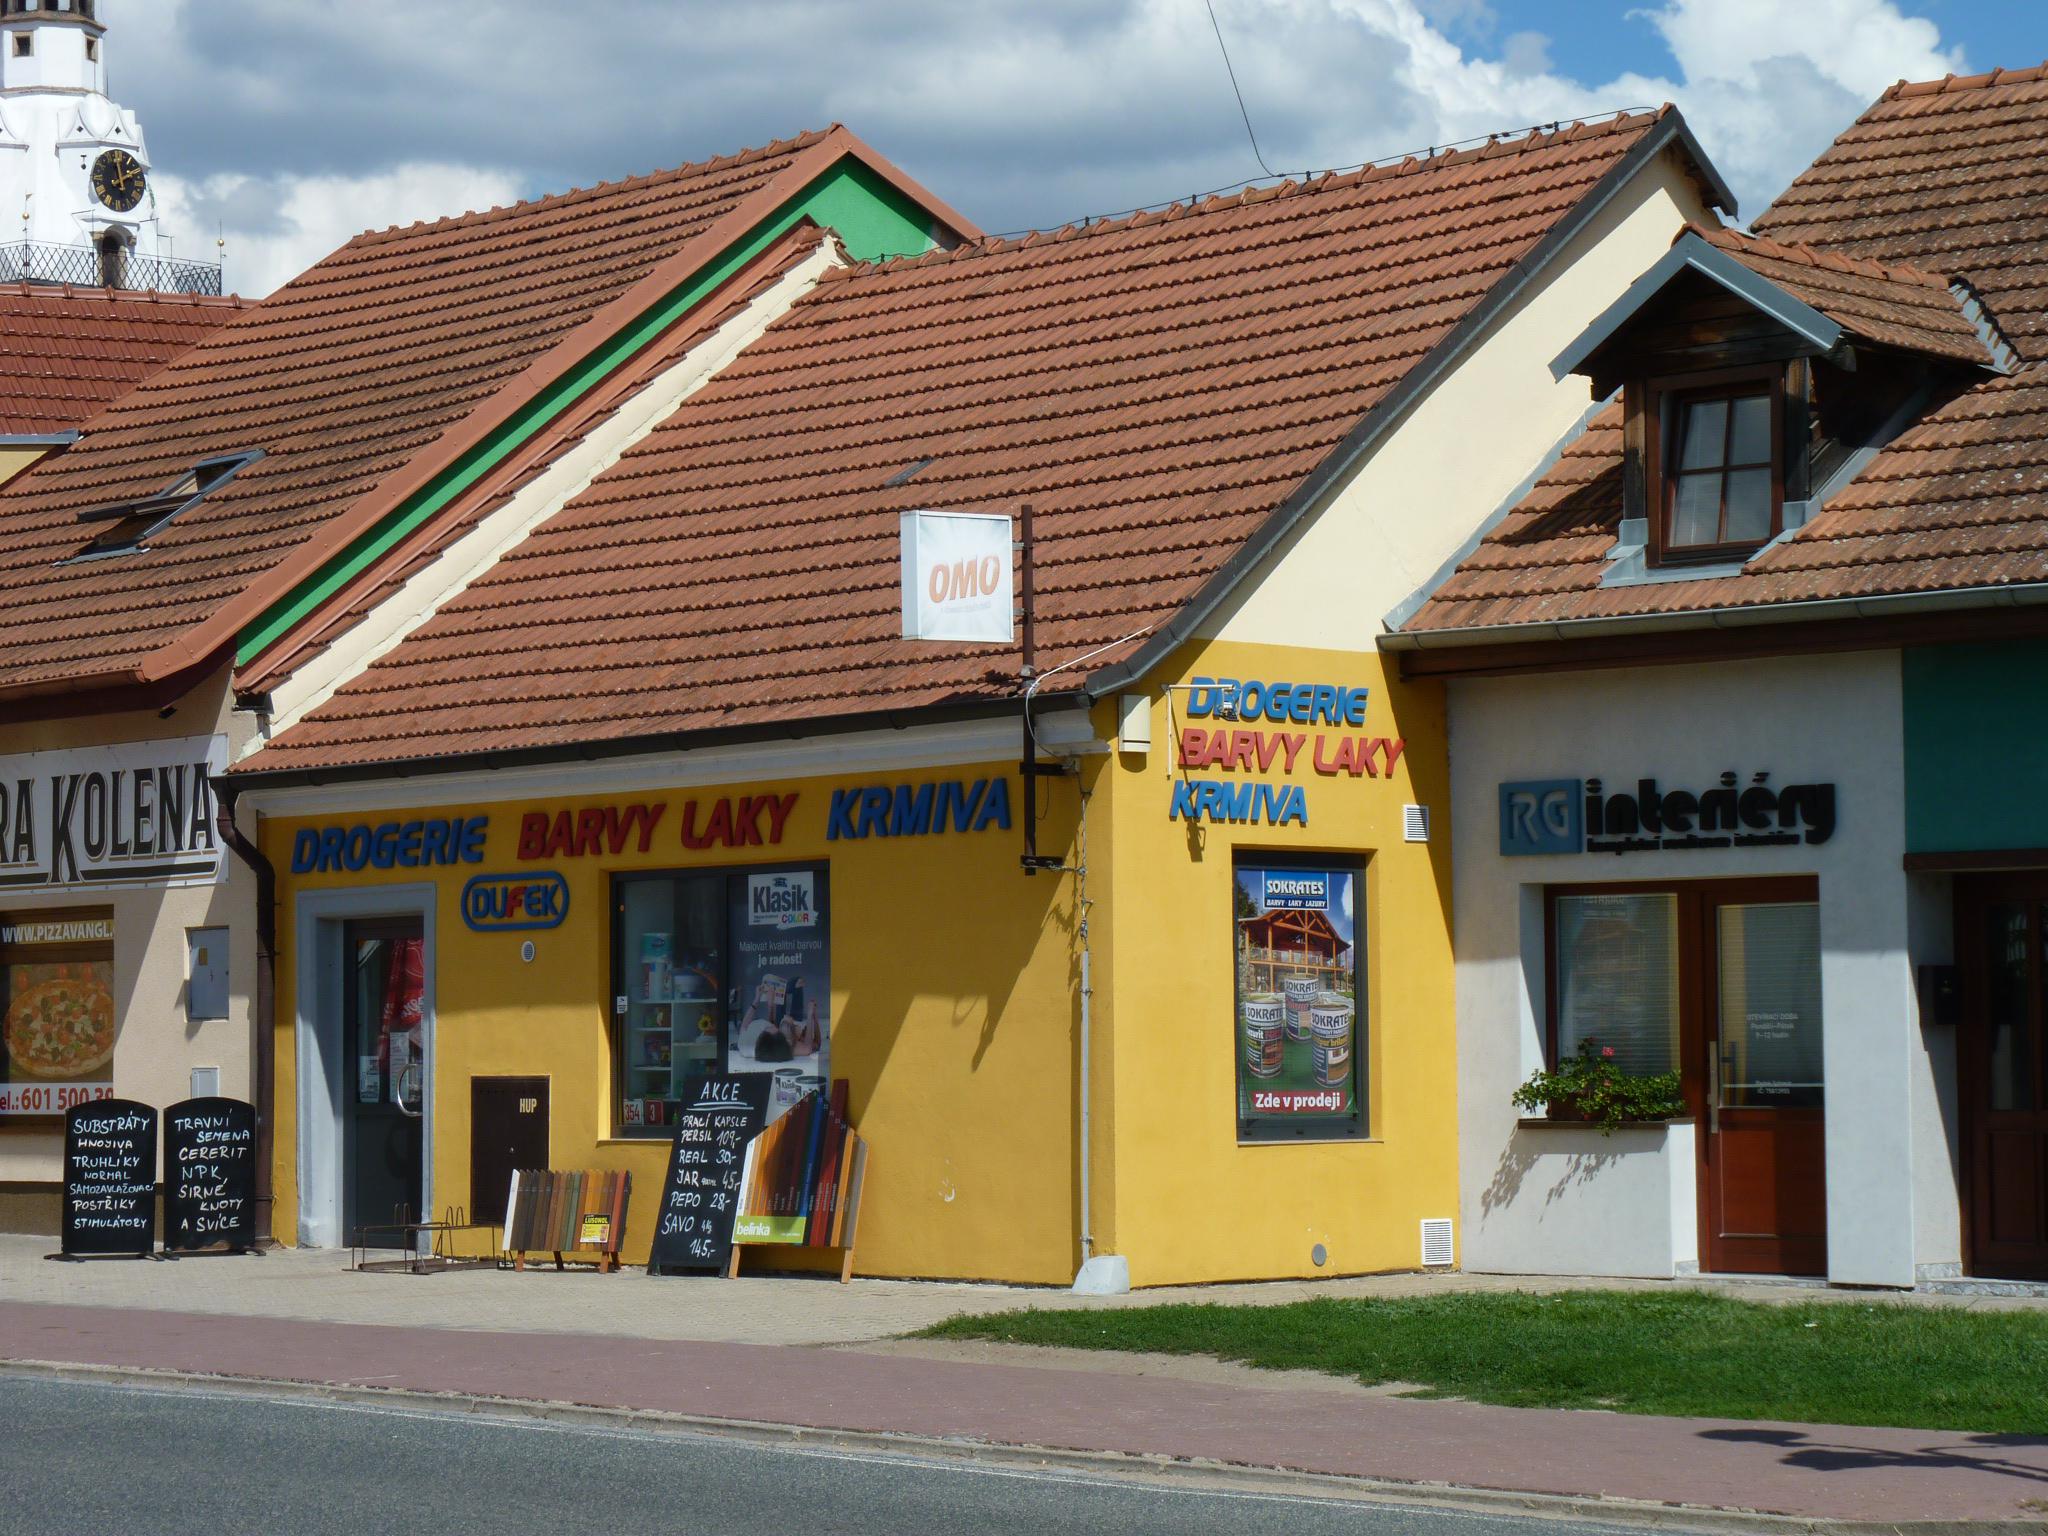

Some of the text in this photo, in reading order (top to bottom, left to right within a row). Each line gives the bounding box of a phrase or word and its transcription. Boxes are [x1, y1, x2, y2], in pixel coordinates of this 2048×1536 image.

[928, 555, 1000, 604] OMO
[1187, 677, 1368, 727] DROGERIE
[1178, 728, 1406, 778] BARVY LAKY
[1169, 780, 1309, 827] KRMIVA
[51, 762, 216, 883] KOLENA
[1508, 789, 1569, 842] RG
[290, 778, 1012, 873] DROGERIE BARVY LAKY KRMIVA
[1266, 880, 1325, 896] SOKRATES
[472, 884, 560, 919] DUFEK
[753, 884, 808, 913] Klasik
[781, 913, 809, 924] COLOR
[2, 922, 114, 942] WWW.PIZZAVANGL.
[757, 953, 802, 969] je radost!
[700, 1082, 741, 1101] AKCE
[519, 1098, 537, 1113] HUP
[1255, 1092, 1340, 1111] Zde v prodeji
[73, 1110, 150, 1134] SUBSTRÁTY
[174, 1108, 233, 1131] TRAVNÍ
[624, 1104, 640, 1121] 354
[650, 1104, 656, 1121] 3
[714, 1115, 748, 1127] KAPSLE
[196, 1129, 250, 1143] SEMENA
[681, 1129, 712, 1143] PERSIL
[72, 1149, 140, 1168] TRUHLÍKY
[178, 1145, 247, 1161] CERERIT
[679, 1149, 708, 1164] REAL
[84, 1170, 131, 1181] NORMAL
[182, 1164, 222, 1181] NPK
[676, 1168, 699, 1188] JAR
[178, 1177, 228, 1200] SIRNÉ
[200, 1198, 244, 1212] KNOTY
[670, 1191, 701, 1208] PEPO
[180, 1213, 241, 1233] A SVÍCE
[661, 1212, 695, 1236] SAVO
[736, 1222, 771, 1237] belinka
